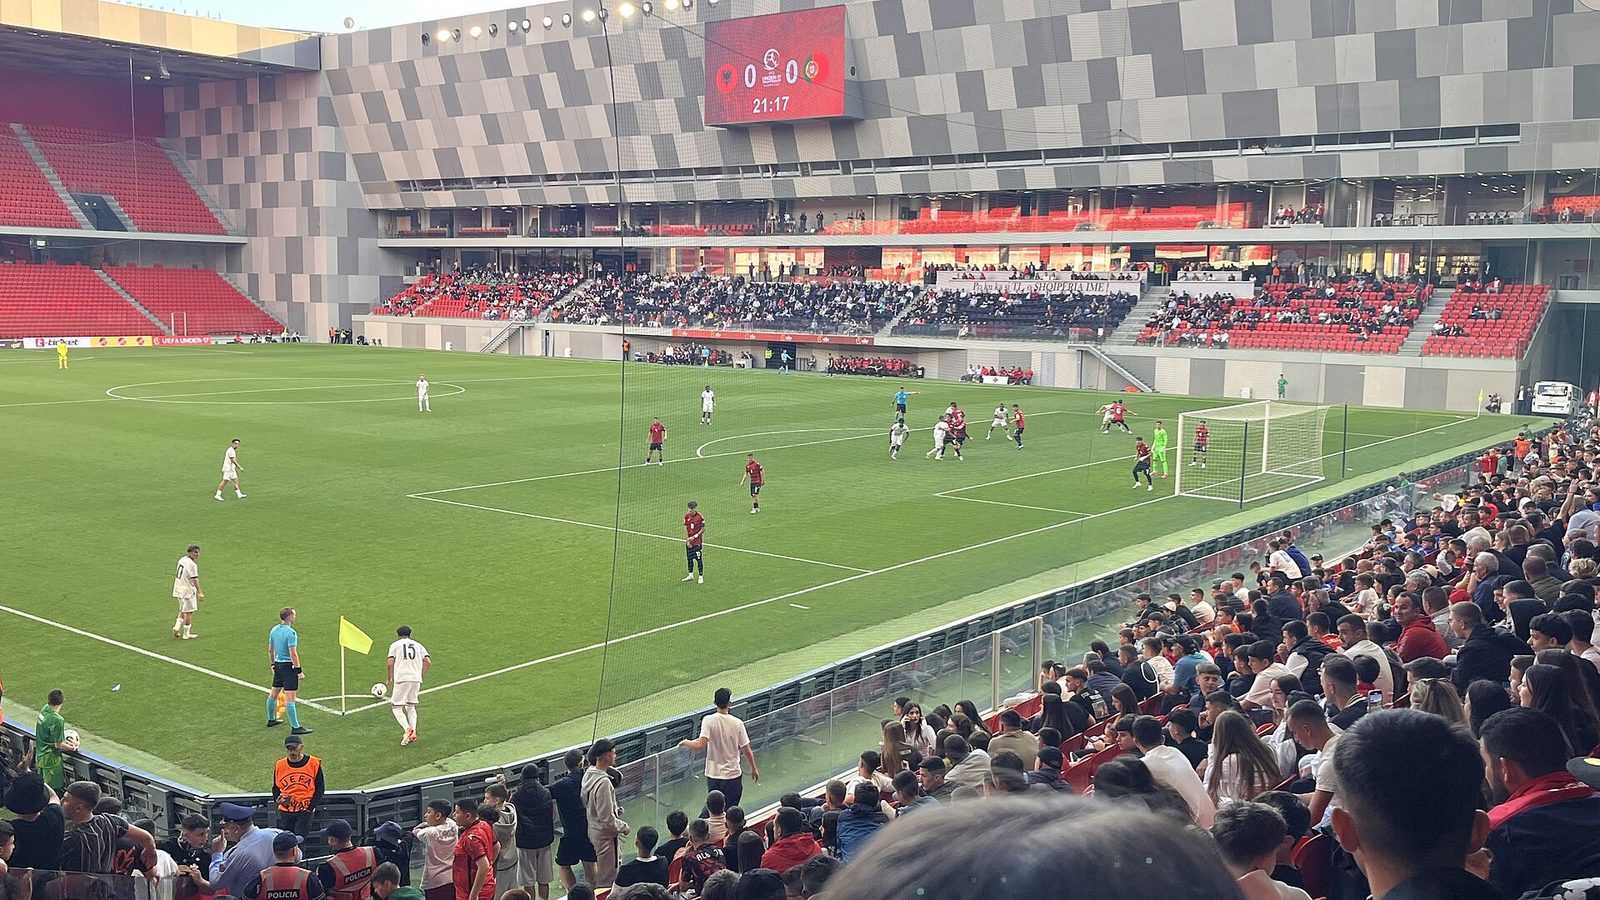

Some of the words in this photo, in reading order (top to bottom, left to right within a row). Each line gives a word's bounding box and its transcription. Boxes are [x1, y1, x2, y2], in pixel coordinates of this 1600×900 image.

[744, 64, 757, 88] 0
[785, 60, 798, 84] 0
[752, 96, 790, 113] 21:17
[161, 337, 180, 345] UEFA
[180, 336, 210, 344] UNDER-17
[402, 643, 416, 660] 15
[280, 775, 312, 788] UEFA
[344, 867, 372, 884] POLICIA
[267, 891, 298, 900] POLICIA
